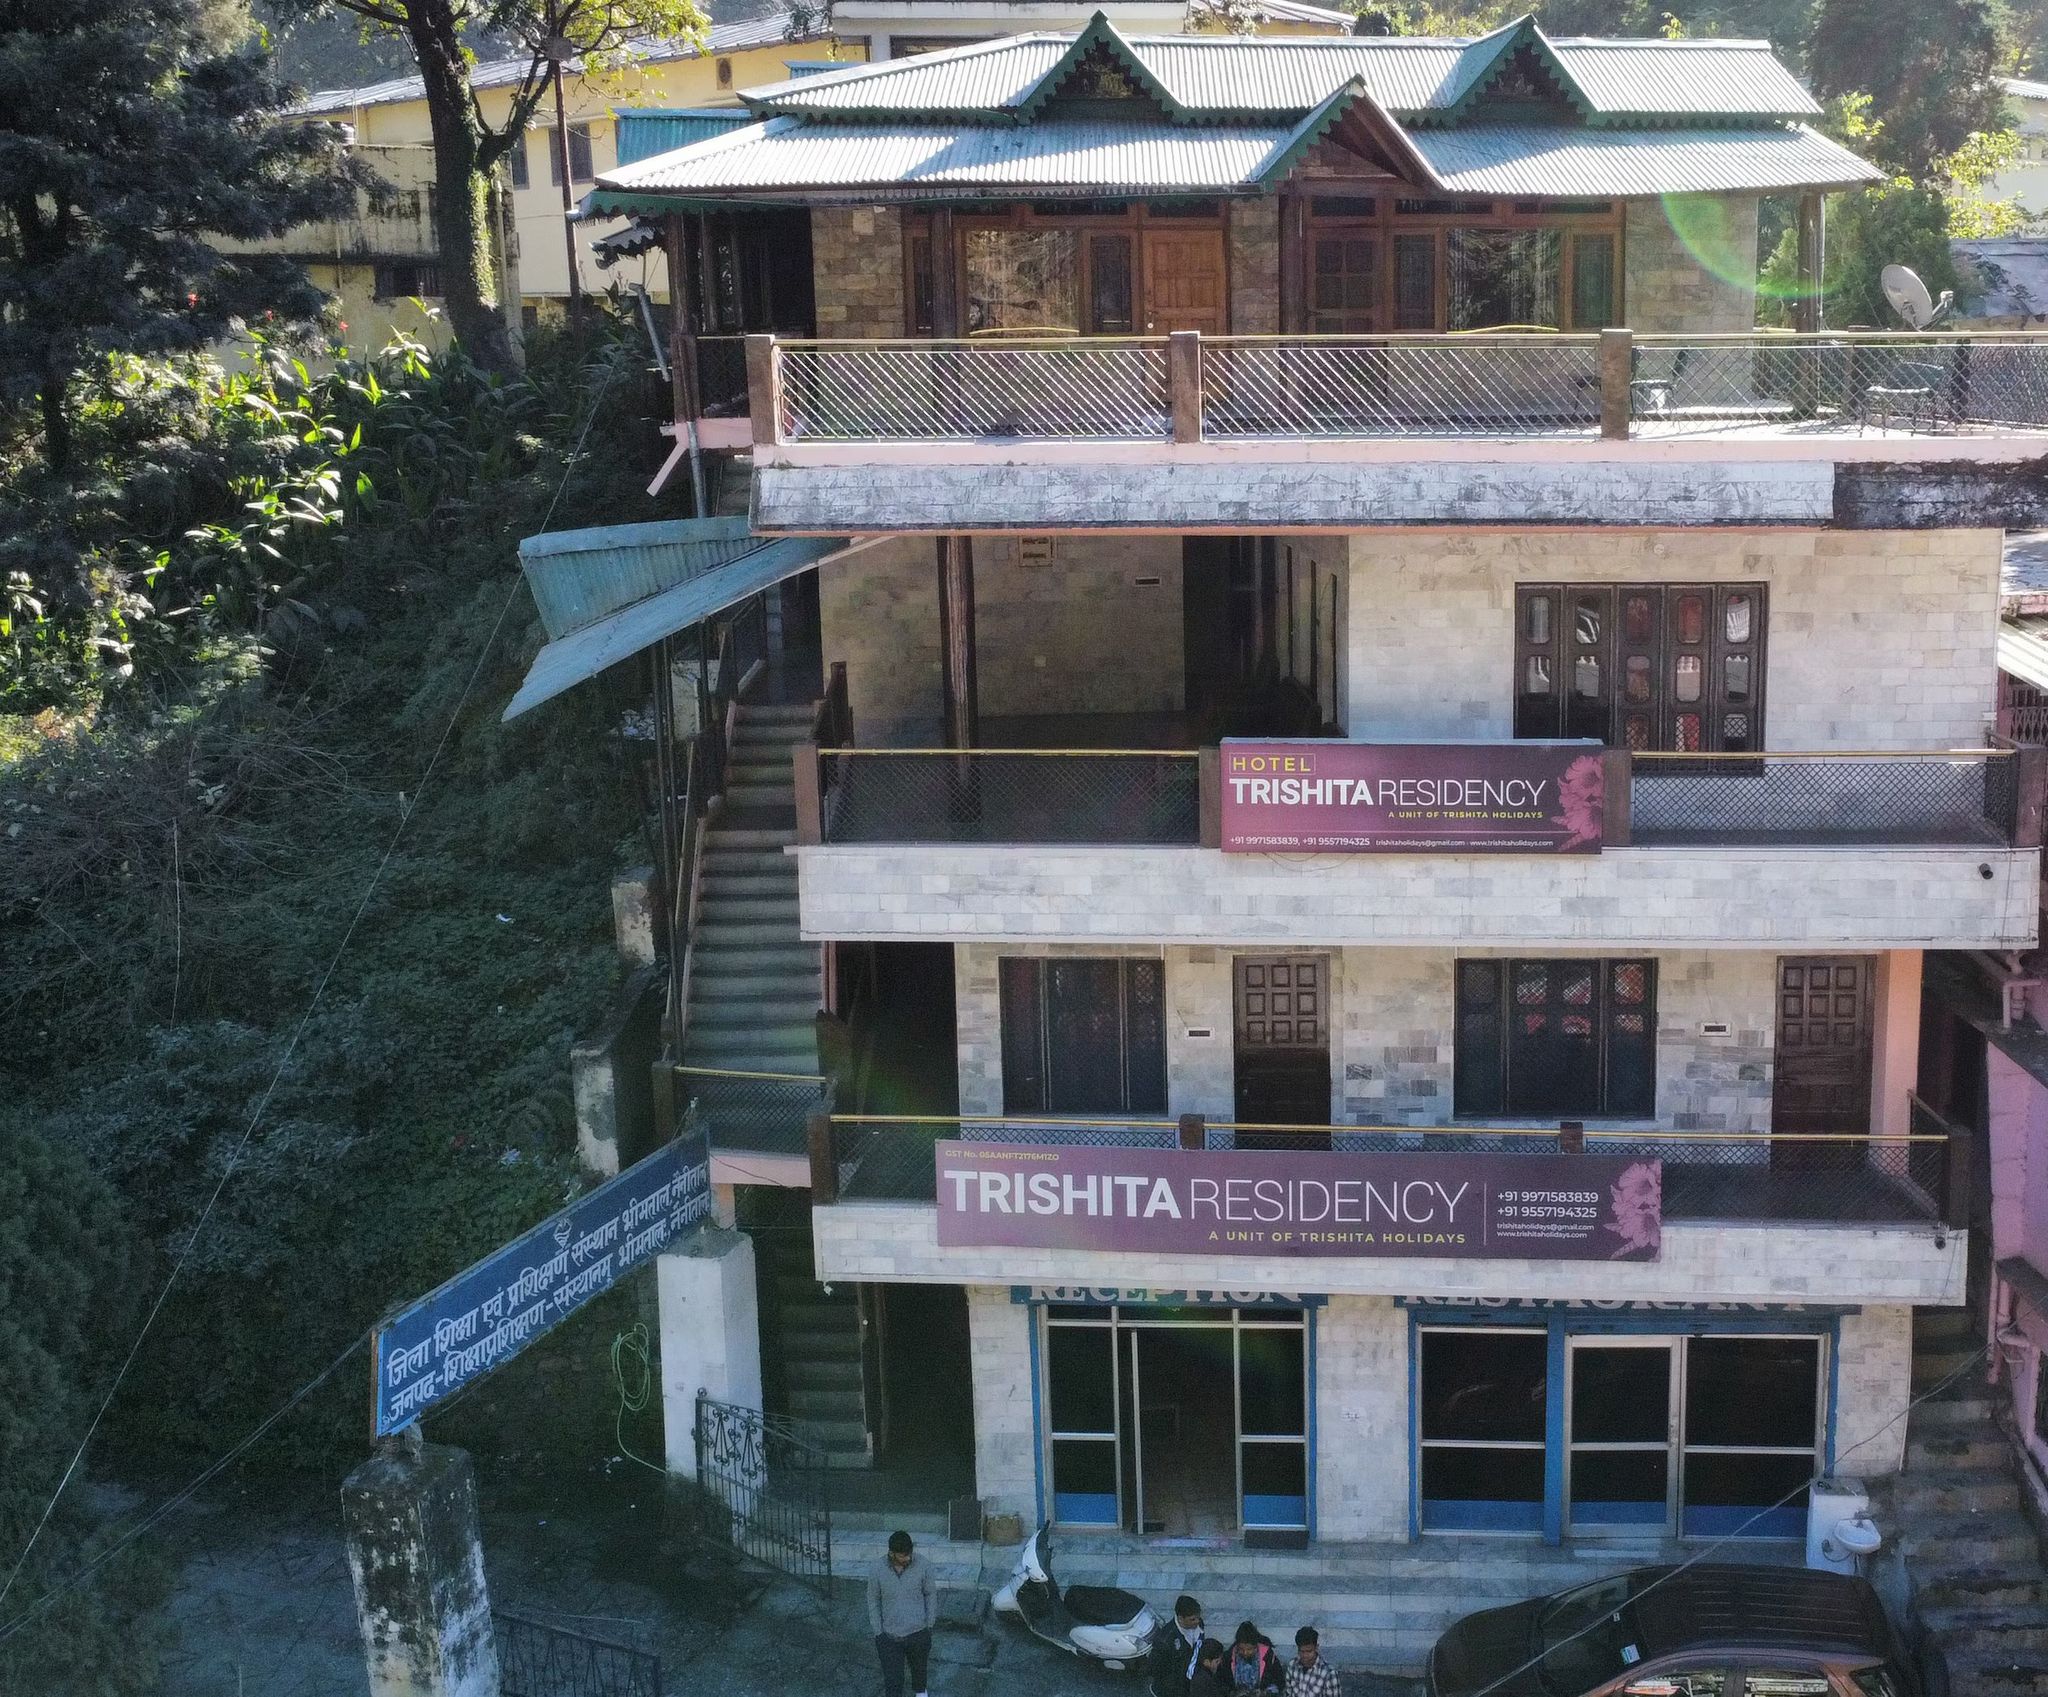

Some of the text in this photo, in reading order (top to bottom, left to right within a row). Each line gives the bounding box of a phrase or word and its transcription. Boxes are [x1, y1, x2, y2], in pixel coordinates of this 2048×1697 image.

[1232, 757, 1311, 772] HOTEL
[1229, 778, 1546, 807] TRISHITA RESIDENCY
[1388, 811, 1544, 819] A UNIT OF TRISHITA HOLIDAYS
[1230, 836, 1244, 845] +91
[1302, 837, 1317, 846] +91
[1318, 837, 1371, 847] 9557194325
[1375, 839, 1466, 848] trishitaholidays@gmail.com
[1469, 840, 1554, 848] www.trishitaholidays.com
[945, 1150, 962, 1158] GST
[963, 1151, 978, 1159] No.
[944, 1170, 1469, 1223] TRISHITA RESIDENCY
[1498, 1191, 1599, 1203] +91 9971583839
[1498, 1206, 1597, 1218] +91 9557194325
[1496, 1222, 1595, 1232] trishitaholidays@gmail.com
[1208, 1231, 1466, 1244] A UNIT OF TRISHITA HOLIDAYS
[1496, 1231, 1587, 1239] www.trishitaholidays.com
[387, 1337, 431, 1388] जिला
[433, 1307, 479, 1357] शिक्षा
[482, 1286, 504, 1329] एवं
[507, 1250, 570, 1316] प्रशिक्षण
[571, 1215, 620, 1267] संस्थान
